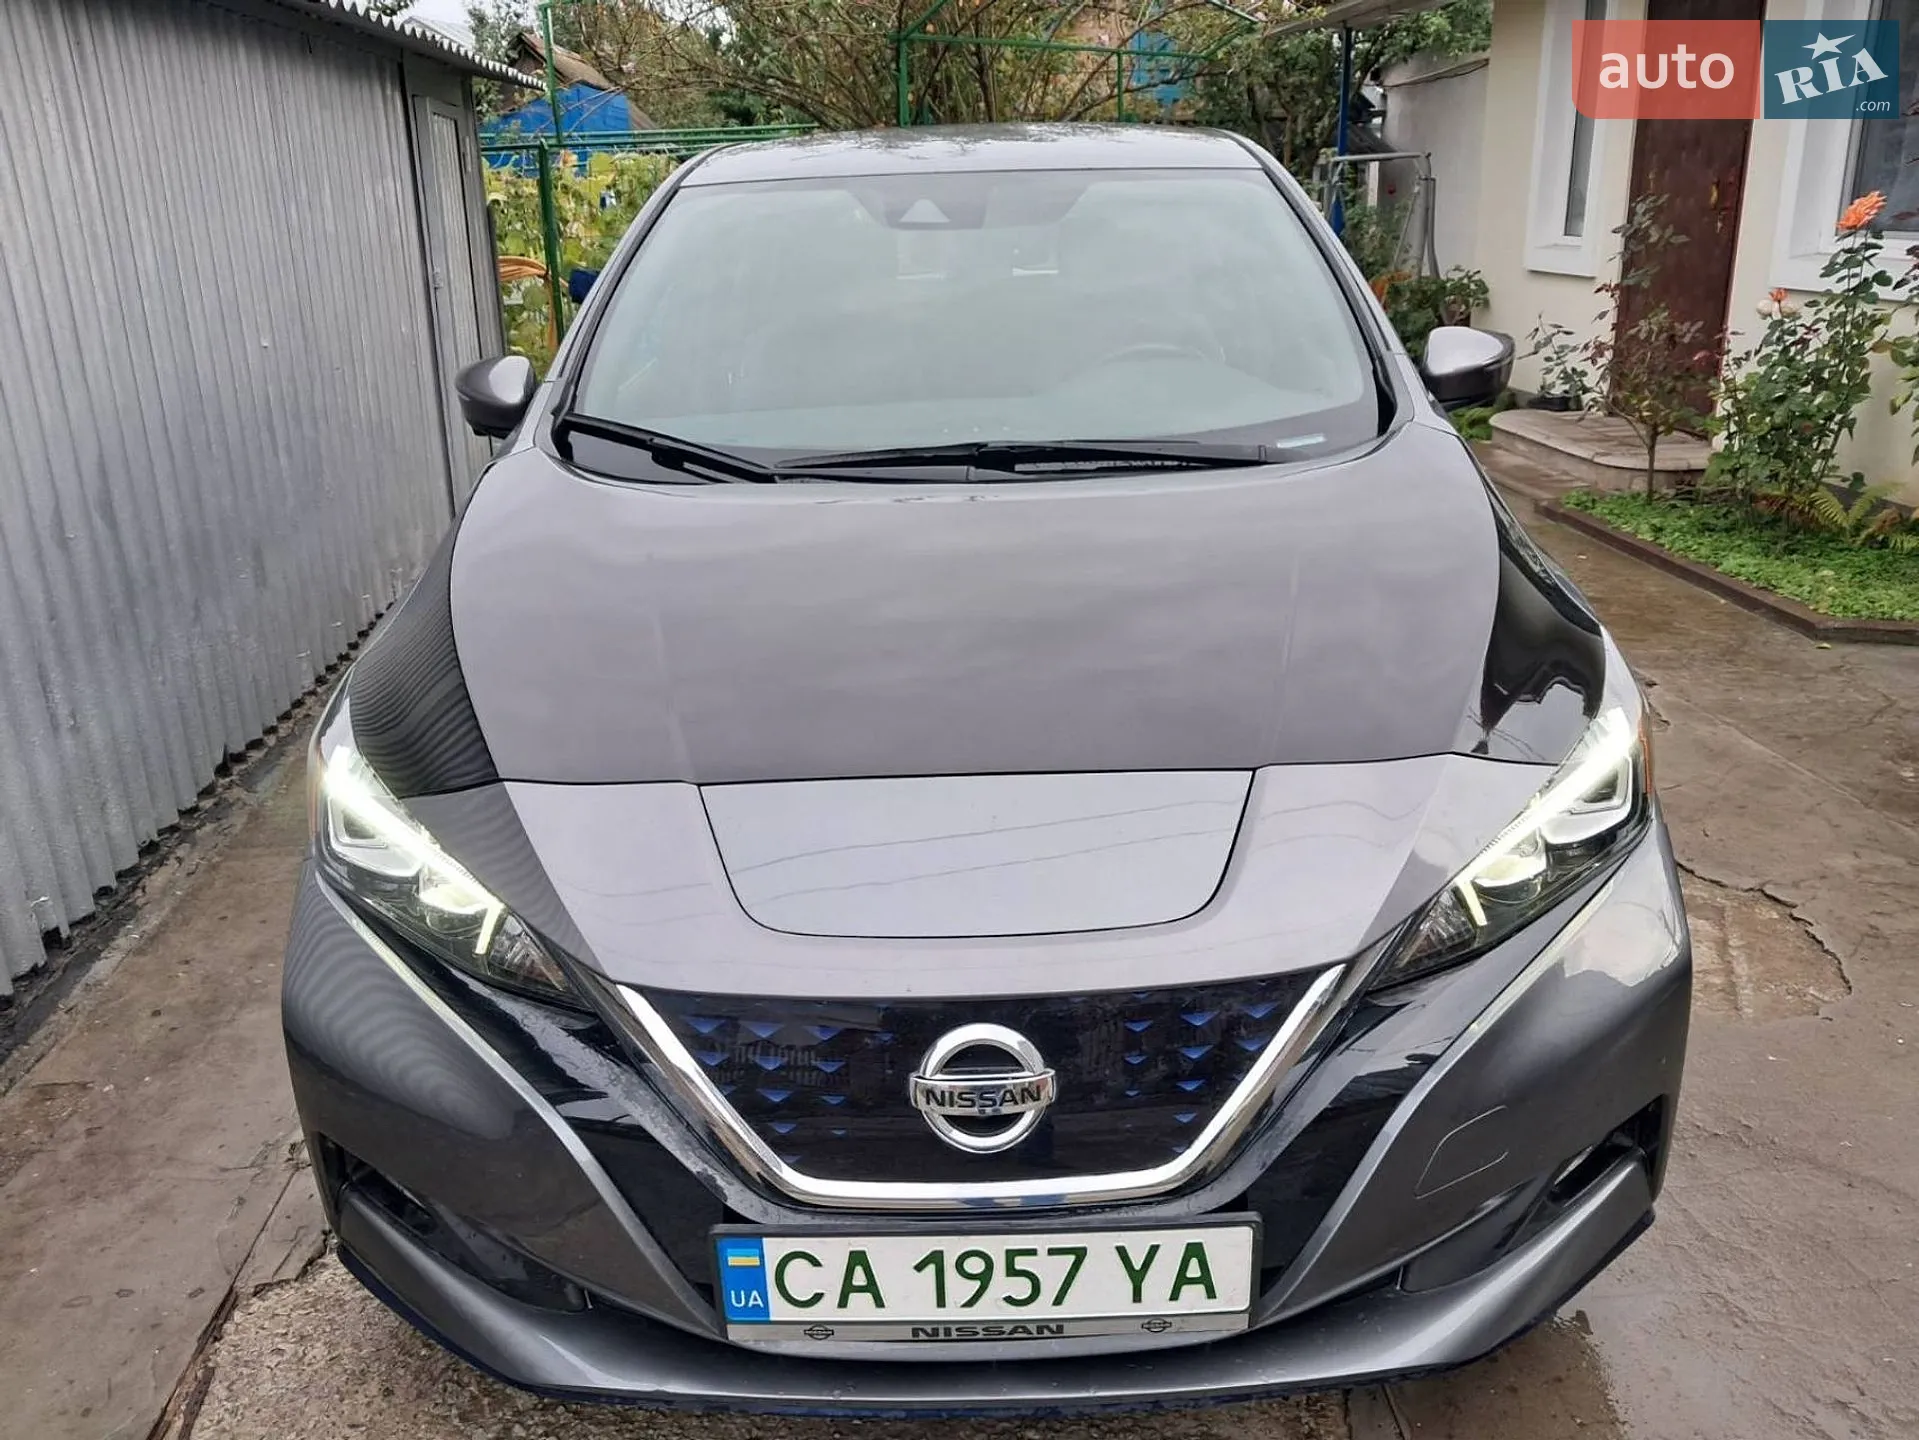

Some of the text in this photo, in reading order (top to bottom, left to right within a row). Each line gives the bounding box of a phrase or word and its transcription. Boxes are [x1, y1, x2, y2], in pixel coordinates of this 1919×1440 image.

[925, 1085, 1041, 1109] NISSAN
[774, 1241, 1217, 1309] CA 1957 YA
[731, 1290, 764, 1309] UA
[911, 1323, 1064, 1338] NISSAN
